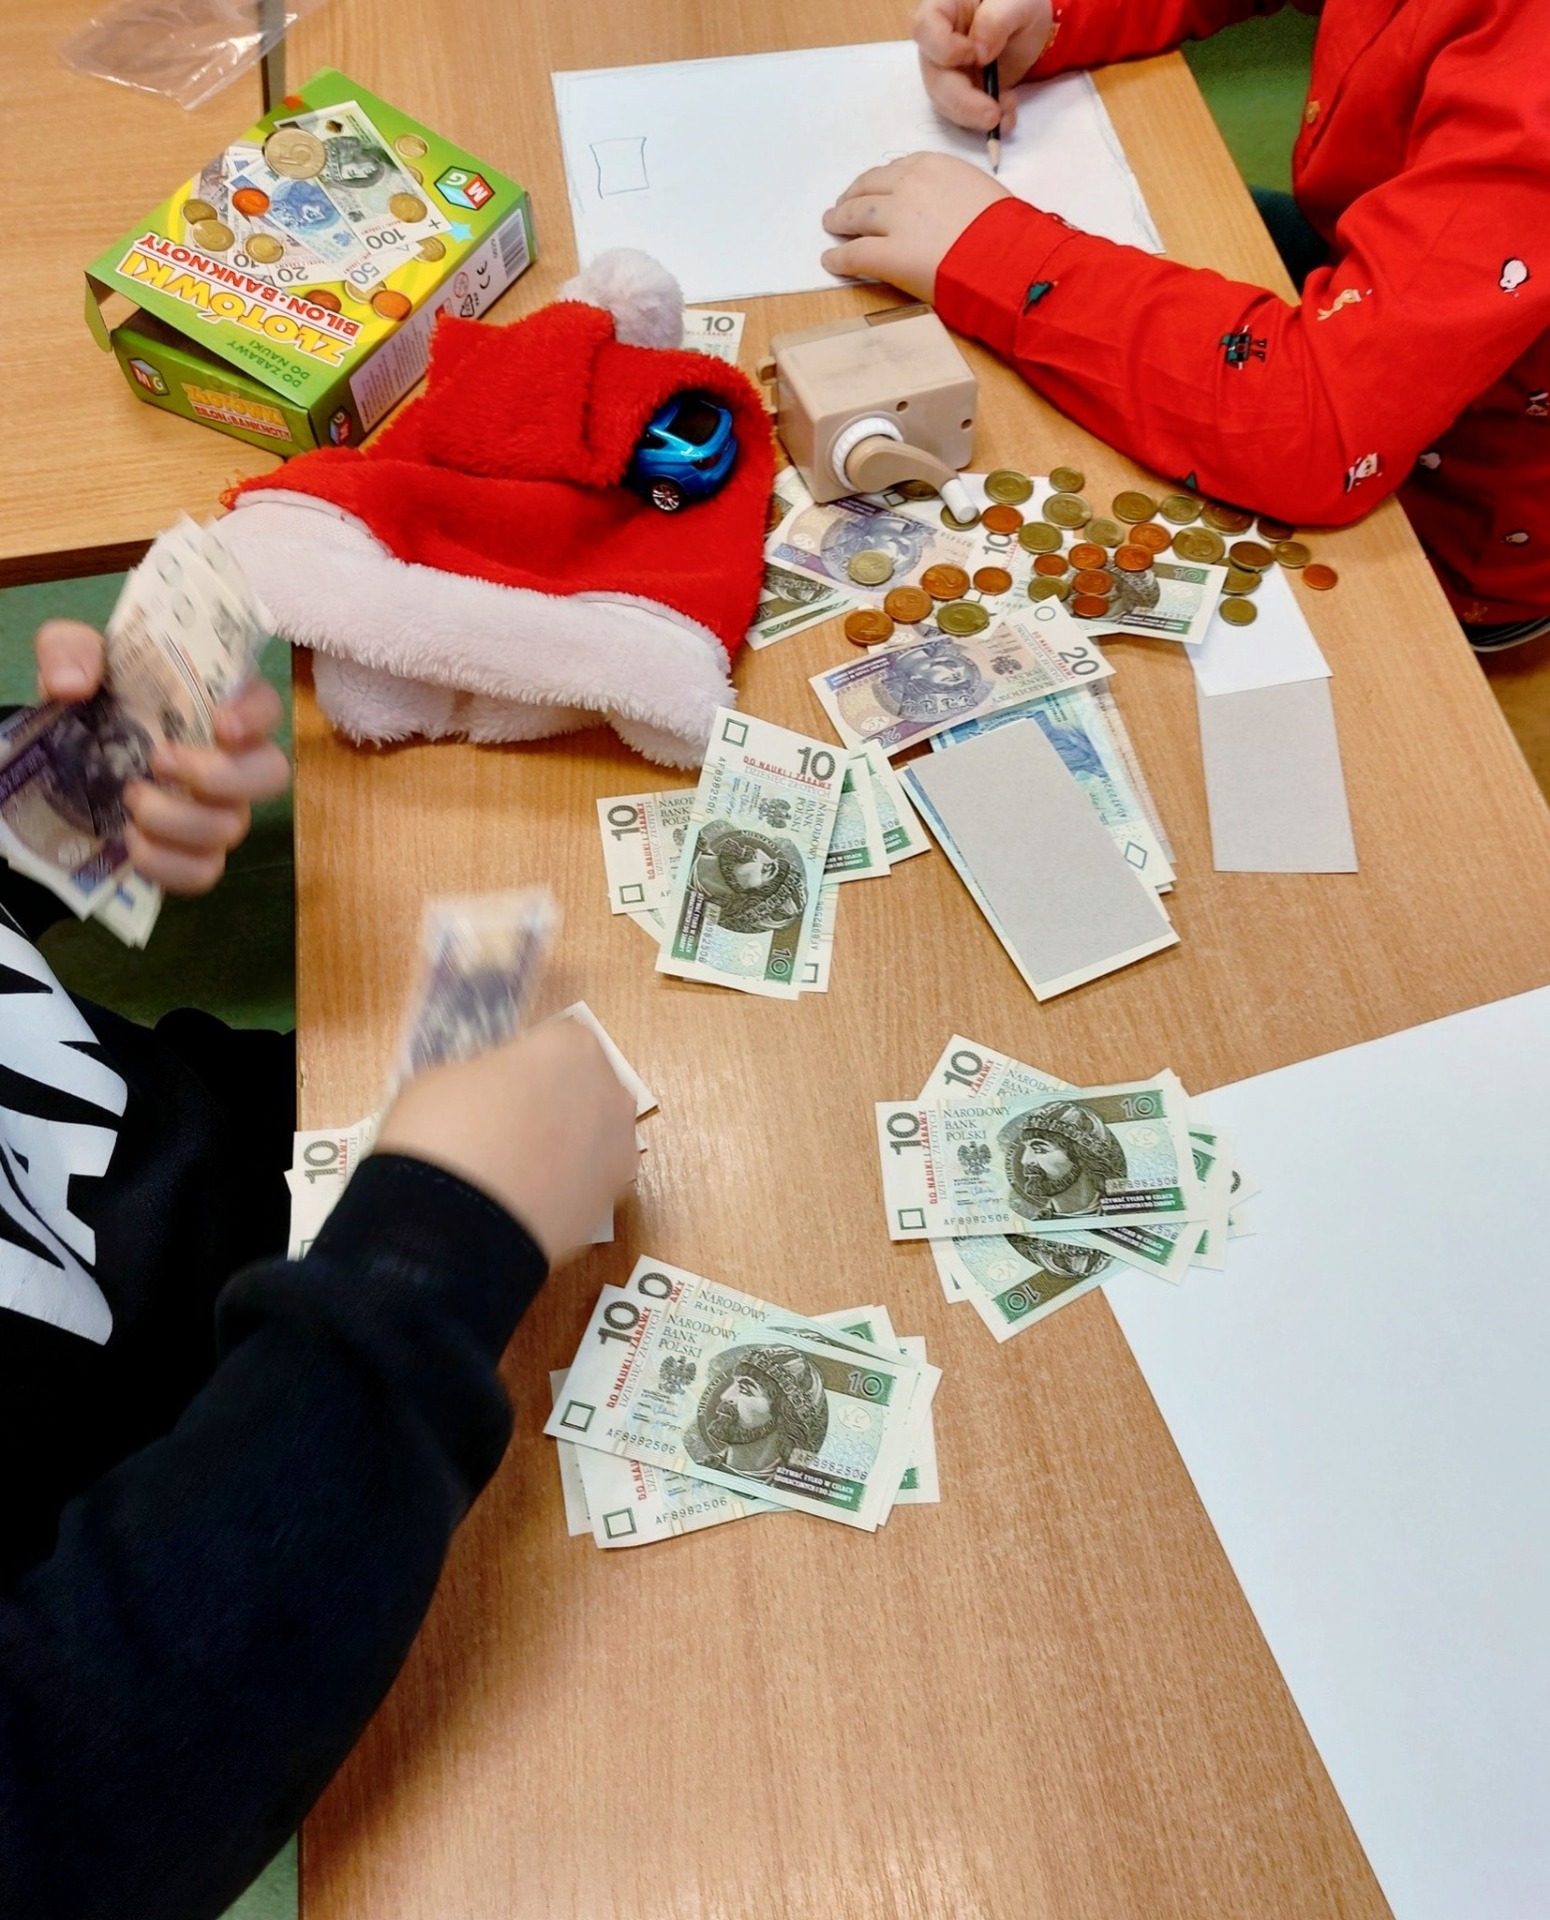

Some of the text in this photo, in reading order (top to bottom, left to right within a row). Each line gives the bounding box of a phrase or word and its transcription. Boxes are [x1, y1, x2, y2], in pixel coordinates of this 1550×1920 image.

[366, 228, 406, 250] 100
[138, 234, 361, 337] BILON BANKNOTY
[277, 266, 308, 283] 20
[350, 261, 380, 285] 50
[121, 250, 348, 363] ZŁOTÓWKI
[702, 316, 735, 333] 10
[226, 341, 302, 388] DO ZABAWY
[248, 339, 310, 380] DO NAUKI
[1174, 567, 1201, 582] 10
[1058, 646, 1100, 676] 20
[743, 755, 757, 766] DO
[759, 761, 785, 776] NAUKI
[795, 774, 832, 790] ZABAWY
[797, 746, 836, 781] 10
[705, 756, 726, 816] AF8982506
[607, 804, 640, 841] 10
[788, 796, 808, 833] POLSKI
[801, 799, 817, 828] BANK
[805, 803, 828, 863] NARODOWY
[770, 946, 791, 976] 10
[944, 1050, 983, 1087] 10
[943, 1105, 1011, 1120] NARODOWY
[1120, 1095, 1156, 1117] 10
[885, 1110, 922, 1156] 10
[918, 1110, 930, 1149] ZABAWY
[944, 1119, 977, 1131] BANK
[946, 1130, 987, 1143] POLSKI
[303, 1140, 339, 1184] 10
[924, 1159, 934, 1188] NAUKI
[928, 1192, 937, 1204] DO
[943, 1213, 1010, 1227] AF8982506
[699, 1289, 771, 1323] NARODOWY
[1006, 1284, 1041, 1311] 10
[598, 1301, 641, 1345] 10
[639, 1309, 662, 1358] ZŁOTYCH
[663, 1326, 698, 1344] BANK
[667, 1314, 740, 1342] NARODOWY
[607, 1393, 619, 1409] DO
[613, 1359, 633, 1393] NAUKI
[630, 1306, 652, 1349] ZABAWY
[658, 1338, 703, 1359] POLSKI
[850, 1372, 883, 1397] 10
[606, 1427, 676, 1456] AF8982506
[635, 1485, 647, 1500] DO
[655, 1496, 727, 1524] AF8982506
